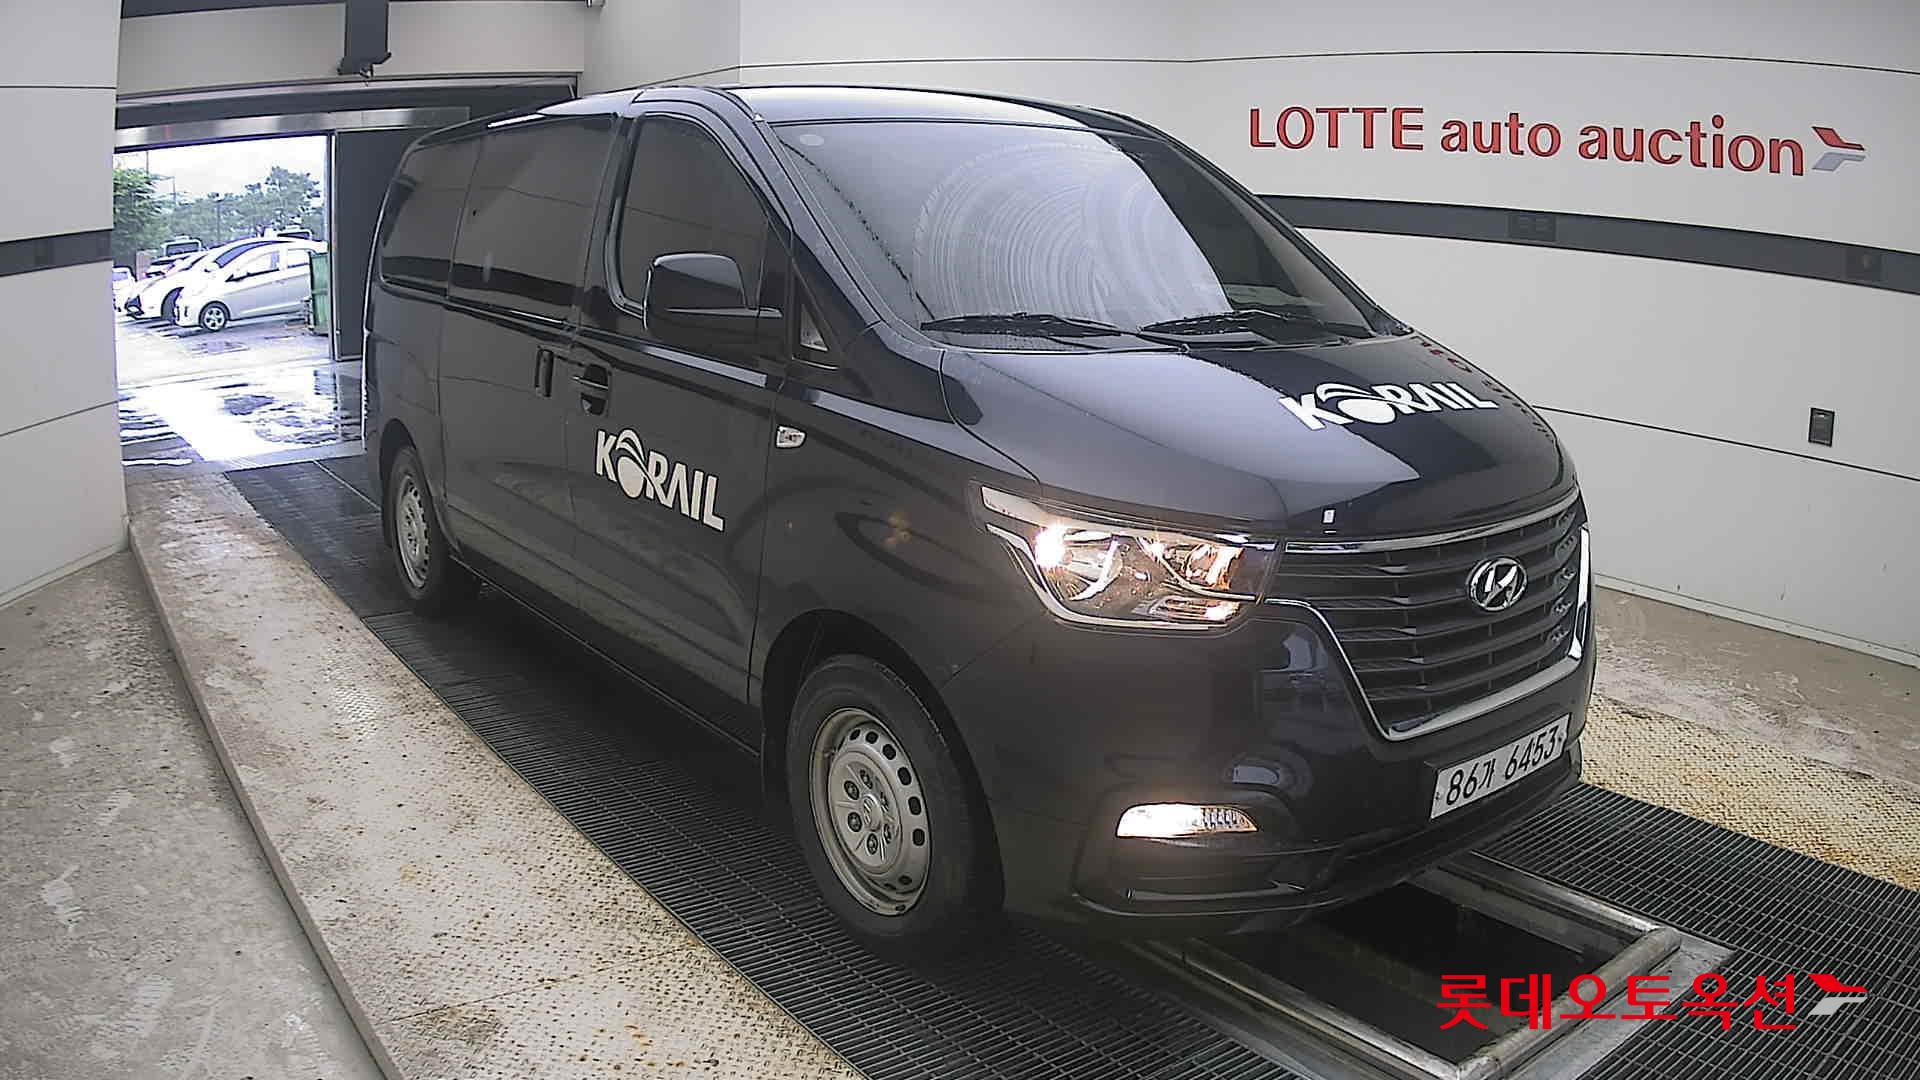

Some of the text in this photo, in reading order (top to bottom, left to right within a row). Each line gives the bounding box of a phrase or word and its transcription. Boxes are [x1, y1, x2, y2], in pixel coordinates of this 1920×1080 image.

[1250, 106, 1804, 176] LOTTE auto auction
[1279, 382, 1499, 430] KORAIL
[595, 429, 724, 532] KORAIL
[1446, 725, 1559, 805] 86가 6453
